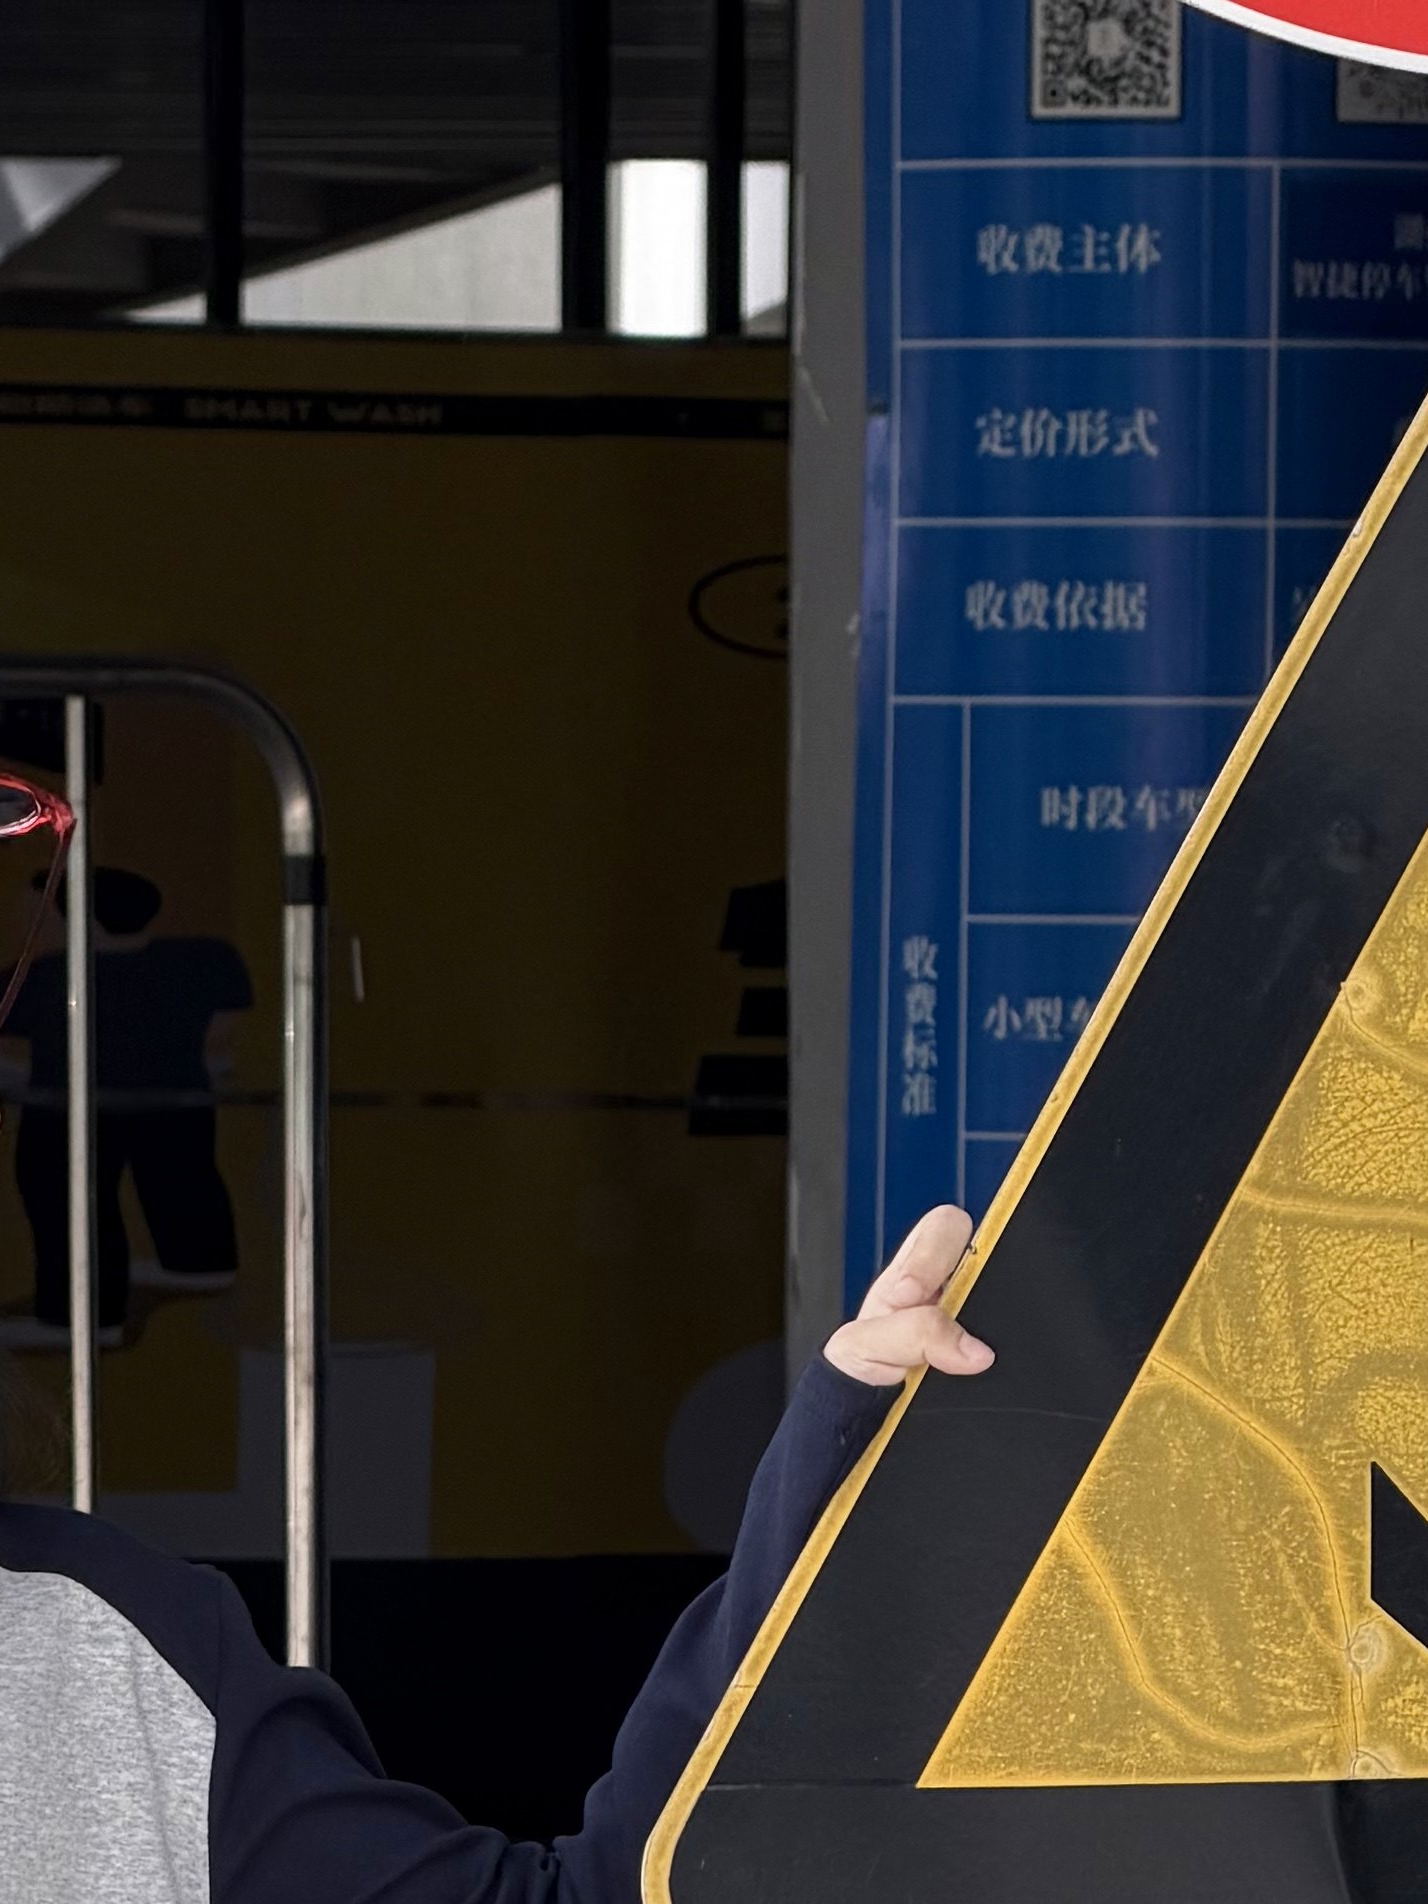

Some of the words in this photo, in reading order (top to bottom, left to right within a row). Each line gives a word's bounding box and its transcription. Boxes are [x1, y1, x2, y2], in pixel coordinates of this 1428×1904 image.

[976, 220, 1162, 275] 收费主体
[184, 394, 313, 424] SMART
[327, 399, 443, 428] WASH
[975, 407, 1159, 458] 定价形式
[966, 580, 1147, 632] 收费依据
[901, 934, 939, 1116] 收费标准
